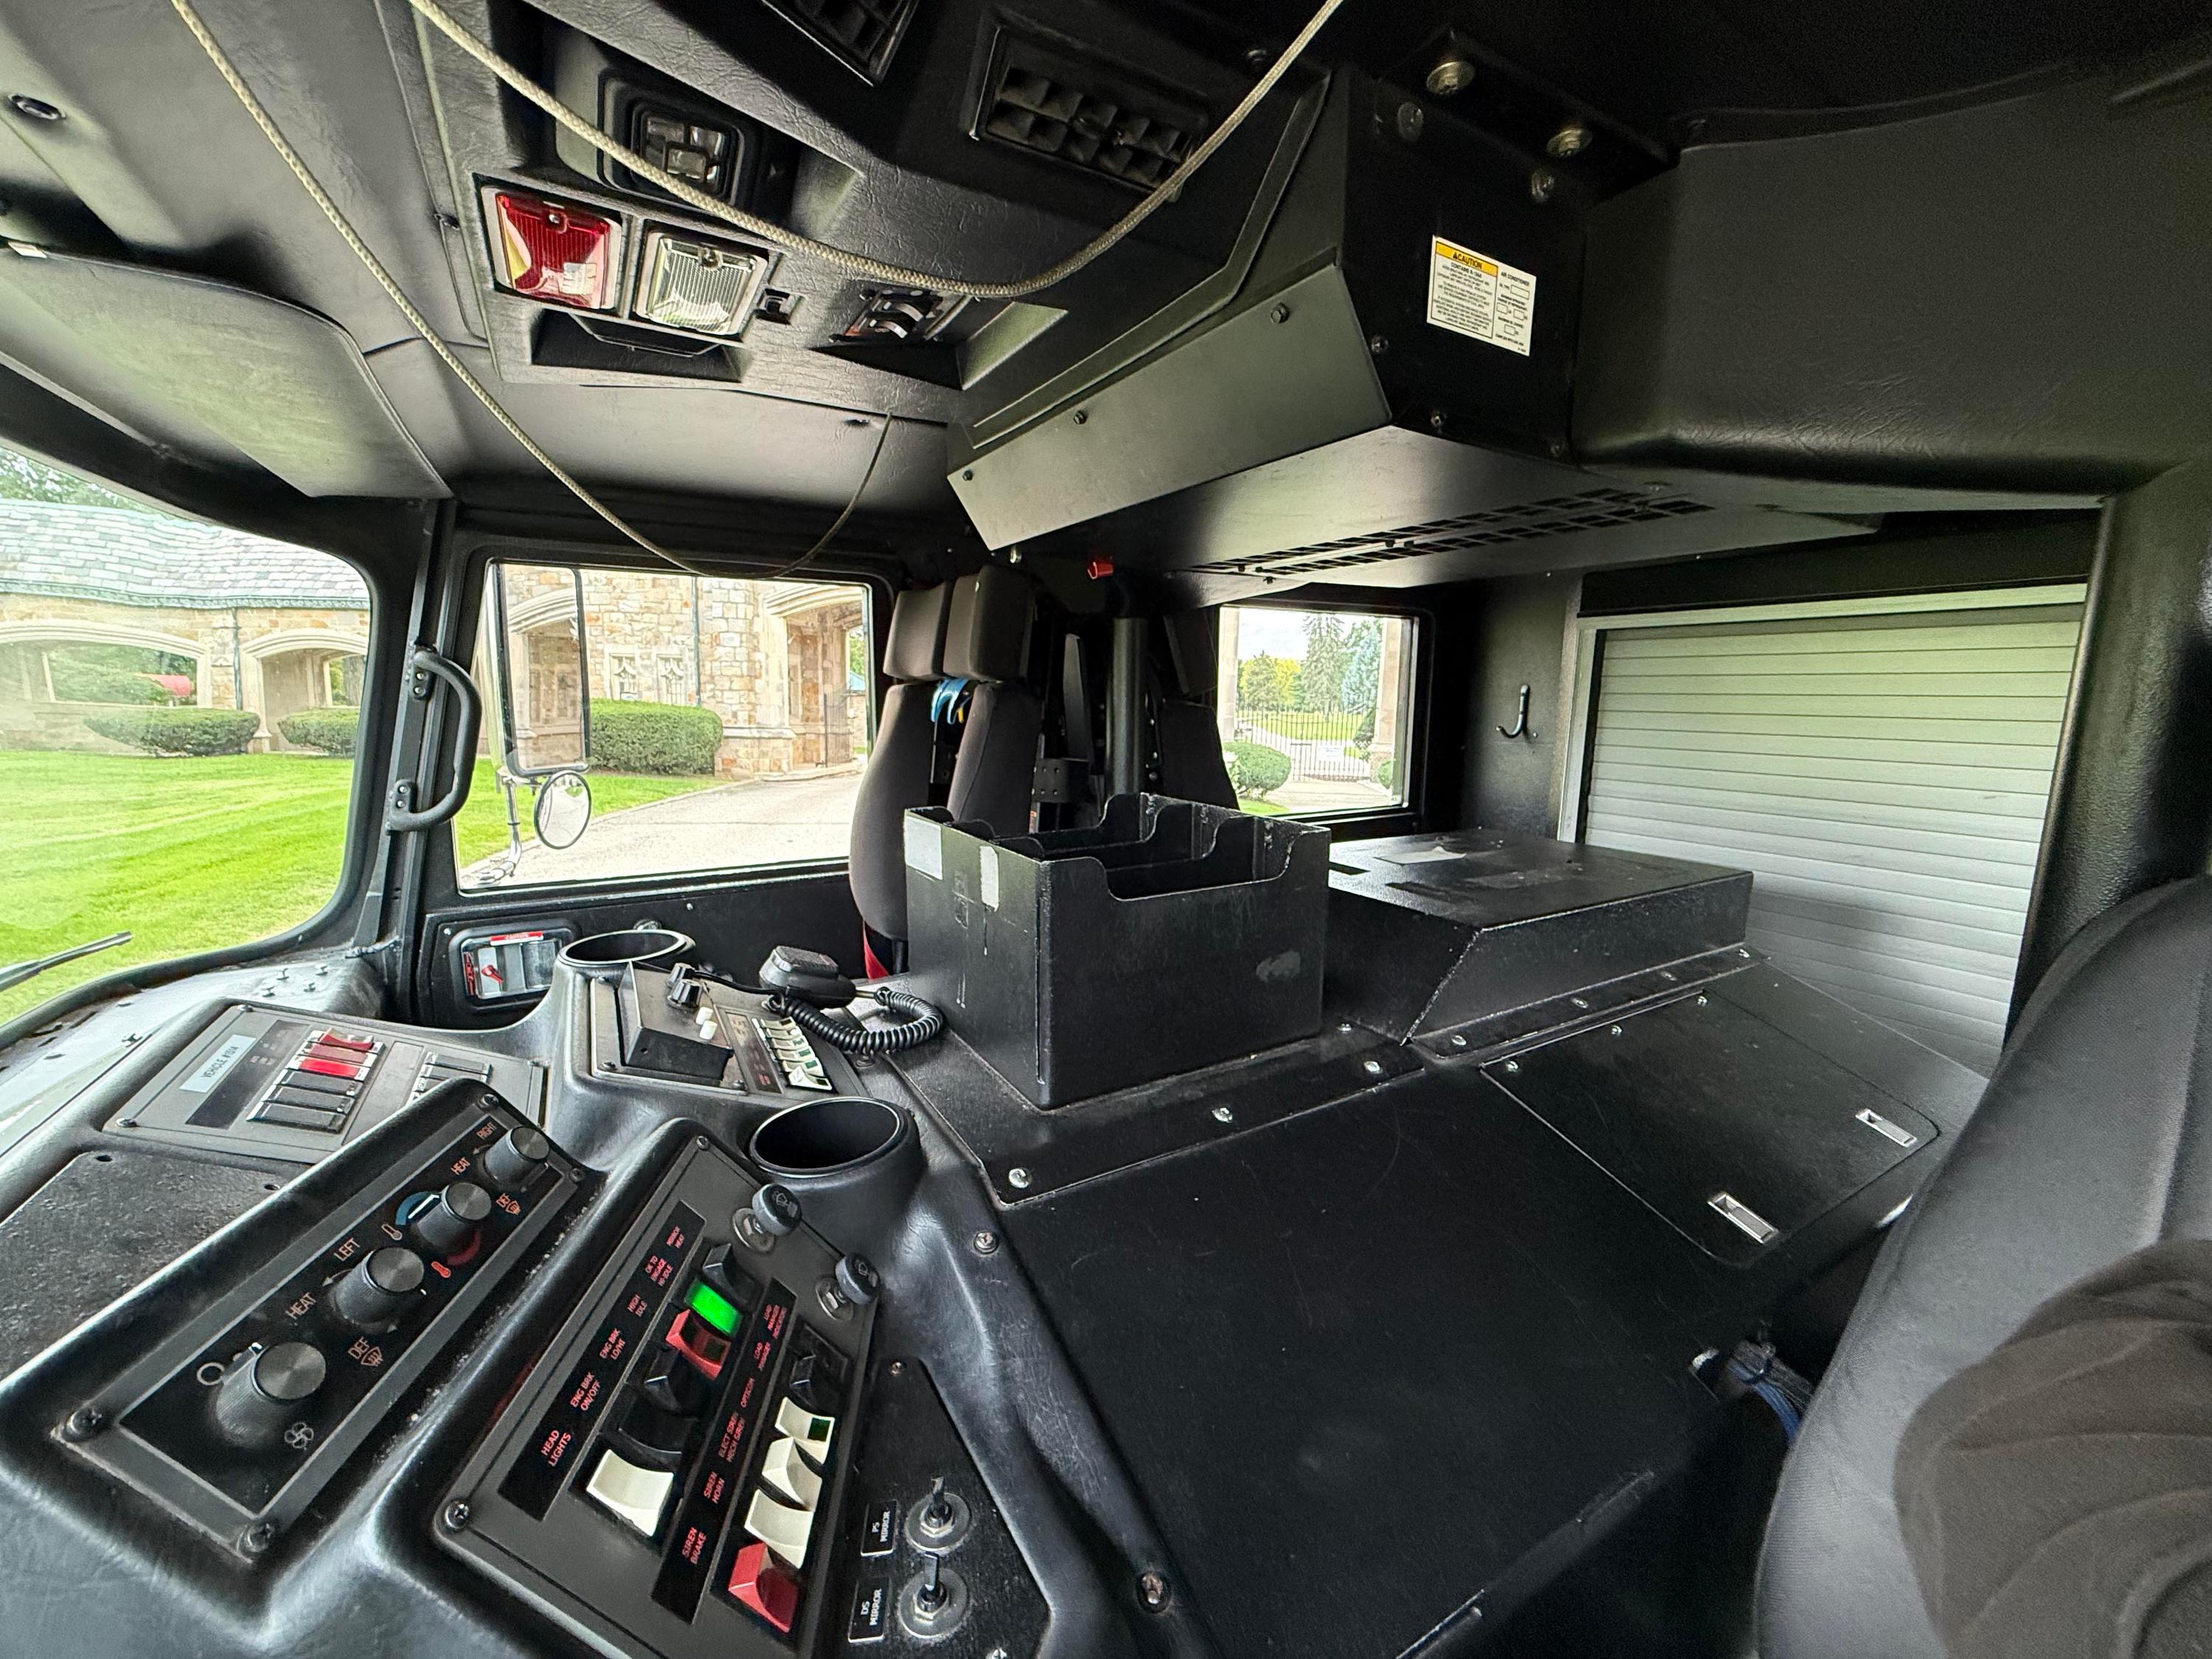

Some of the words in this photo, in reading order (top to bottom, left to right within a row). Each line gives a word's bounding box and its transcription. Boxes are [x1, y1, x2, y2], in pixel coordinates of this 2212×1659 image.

[1458, 254, 1482, 269] CAUTION
[201, 1059, 227, 1077] VEHICLE
[476, 1122, 496, 1140] RIGHT
[451, 1156, 470, 1175] HEAT
[495, 1193, 510, 1208] DEF
[666, 1226, 680, 1246] MIRROR
[675, 1234, 685, 1248] HEAT
[334, 1238, 360, 1262] LEFT
[650, 1256, 658, 1265] TO
[650, 1258, 667, 1281] ENGAGE
[658, 1264, 673, 1287] HI-IDLE
[285, 1293, 316, 1320] HEAT
[627, 1294, 640, 1312] HIGH
[636, 1301, 647, 1317] IDLE
[347, 1336, 369, 1359] DEF
[599, 1342, 612, 1358] ENG
[608, 1328, 622, 1343] BRK
[611, 1338, 625, 1360] LO/HI
[754, 1343, 763, 1360] LOAD
[757, 1342, 771, 1371] MANAGER
[570, 1388, 585, 1408] ENG
[581, 1371, 594, 1389] BRK
[580, 1380, 600, 1411] ON/OFF
[740, 1377, 755, 1408] OPTICOM
[541, 1430, 560, 1456] HEAD
[718, 1433, 731, 1458] ELECT
[726, 1411, 739, 1435] SIREN
[726, 1440, 738, 1463] MECH
[734, 1416, 745, 1441] SIREN
[549, 1433, 571, 1467] LIGHTS
[703, 1471, 717, 1498] SIREN
[712, 1477, 725, 1504] HORN
[872, 1521, 880, 1533] PS
[880, 1510, 891, 1543] MIRROR
[682, 1526, 698, 1558] SIREN
[690, 1531, 706, 1565] BRAKE
[860, 1601, 871, 1615] DS
[869, 1588, 883, 1626] MIRROR
